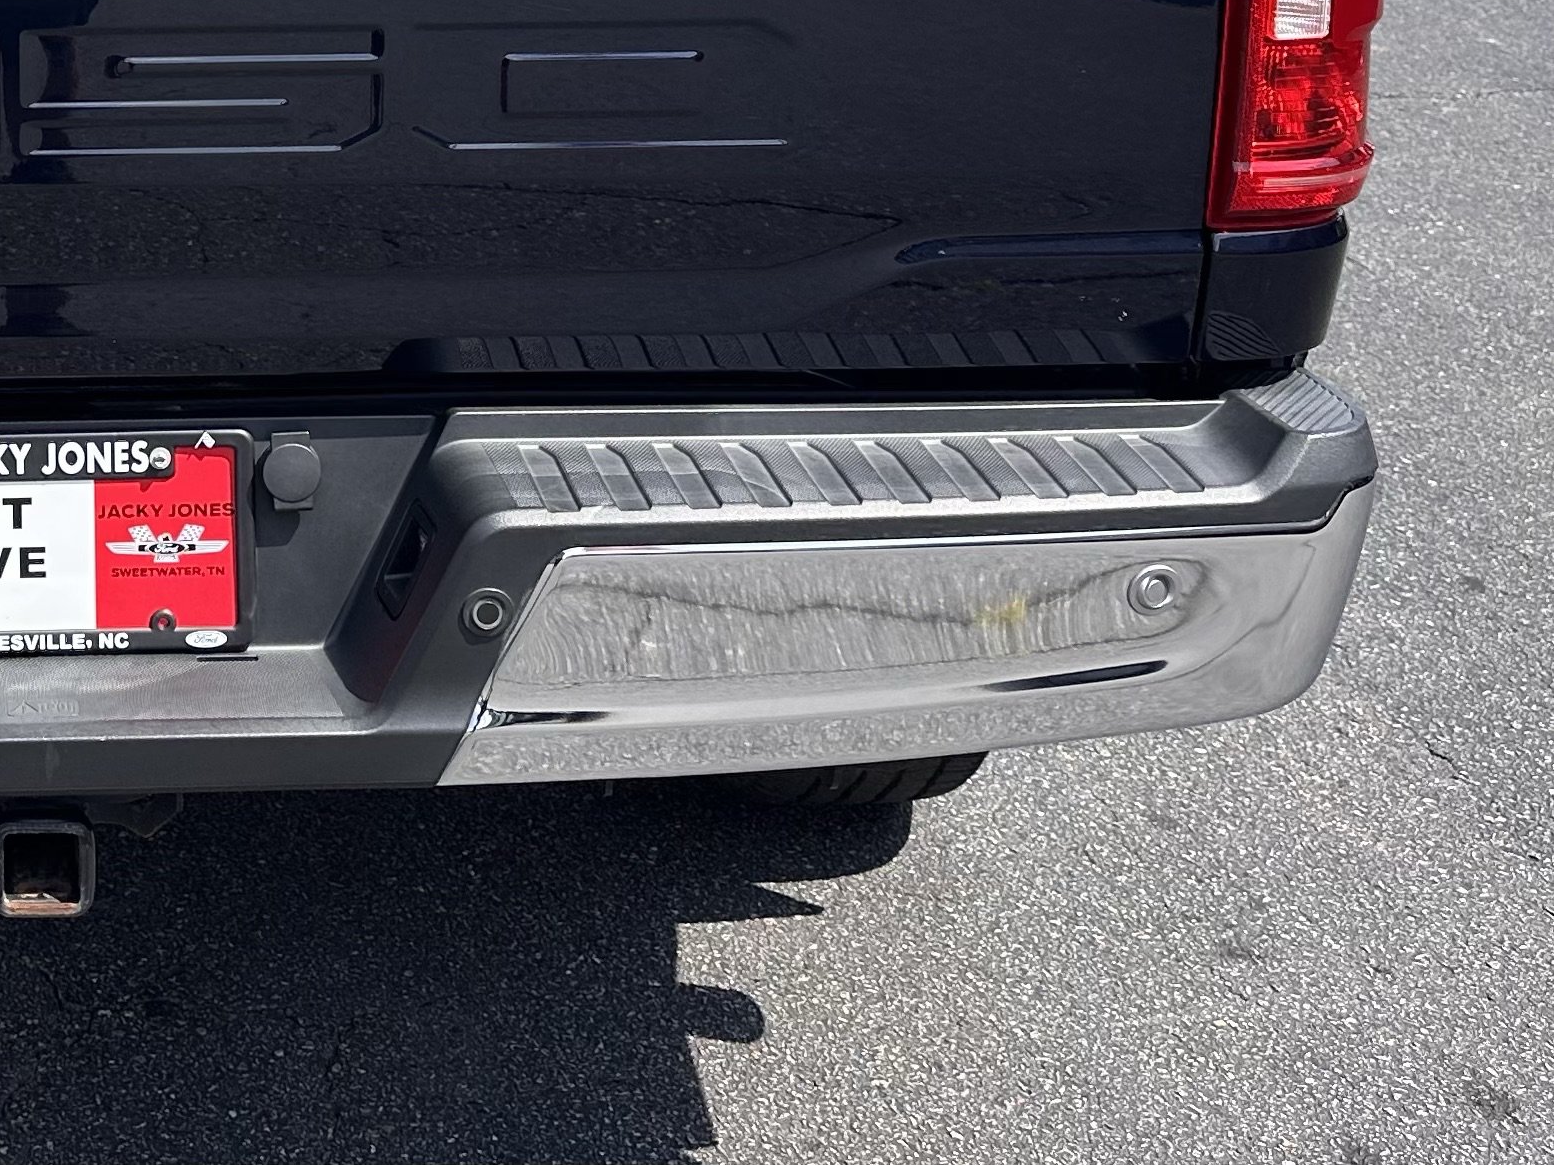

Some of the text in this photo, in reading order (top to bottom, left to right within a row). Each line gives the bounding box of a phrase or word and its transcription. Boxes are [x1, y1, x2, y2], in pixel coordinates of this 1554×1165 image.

[41, 440, 151, 475] JONES
[98, 503, 235, 519] JACKY JONES
[111, 566, 225, 578] SWEETWATER, TN
[98, 633, 130, 649] NC
